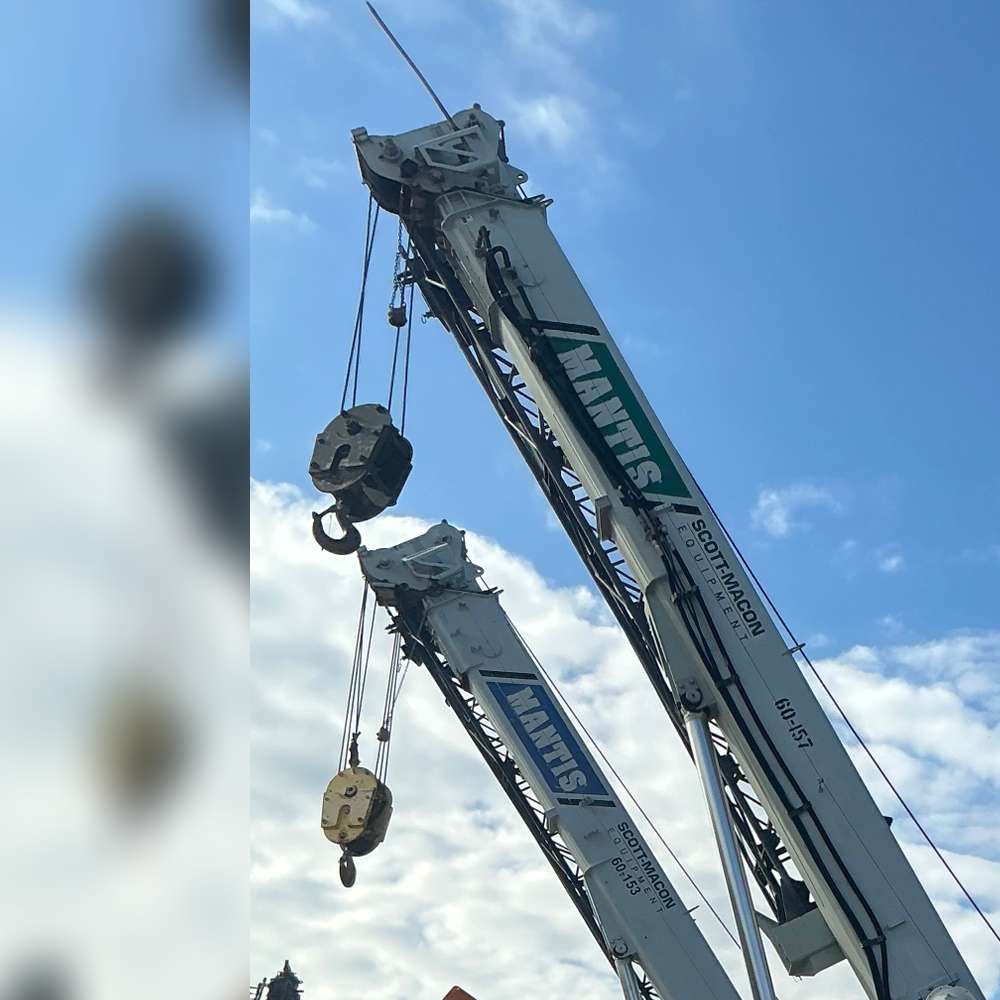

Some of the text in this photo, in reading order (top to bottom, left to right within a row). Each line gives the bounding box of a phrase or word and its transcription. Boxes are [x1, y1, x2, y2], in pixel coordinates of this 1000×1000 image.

[557, 343, 662, 489] MANTIS
[678, 524, 749, 642] EQUIPMENT
[691, 518, 765, 637] SCOTT-MACON
[506, 686, 587, 792] MANTIS
[774, 697, 814, 749] 60-157
[611, 856, 641, 895] 60-153
[617, 821, 676, 909] SCOTT-MACON
